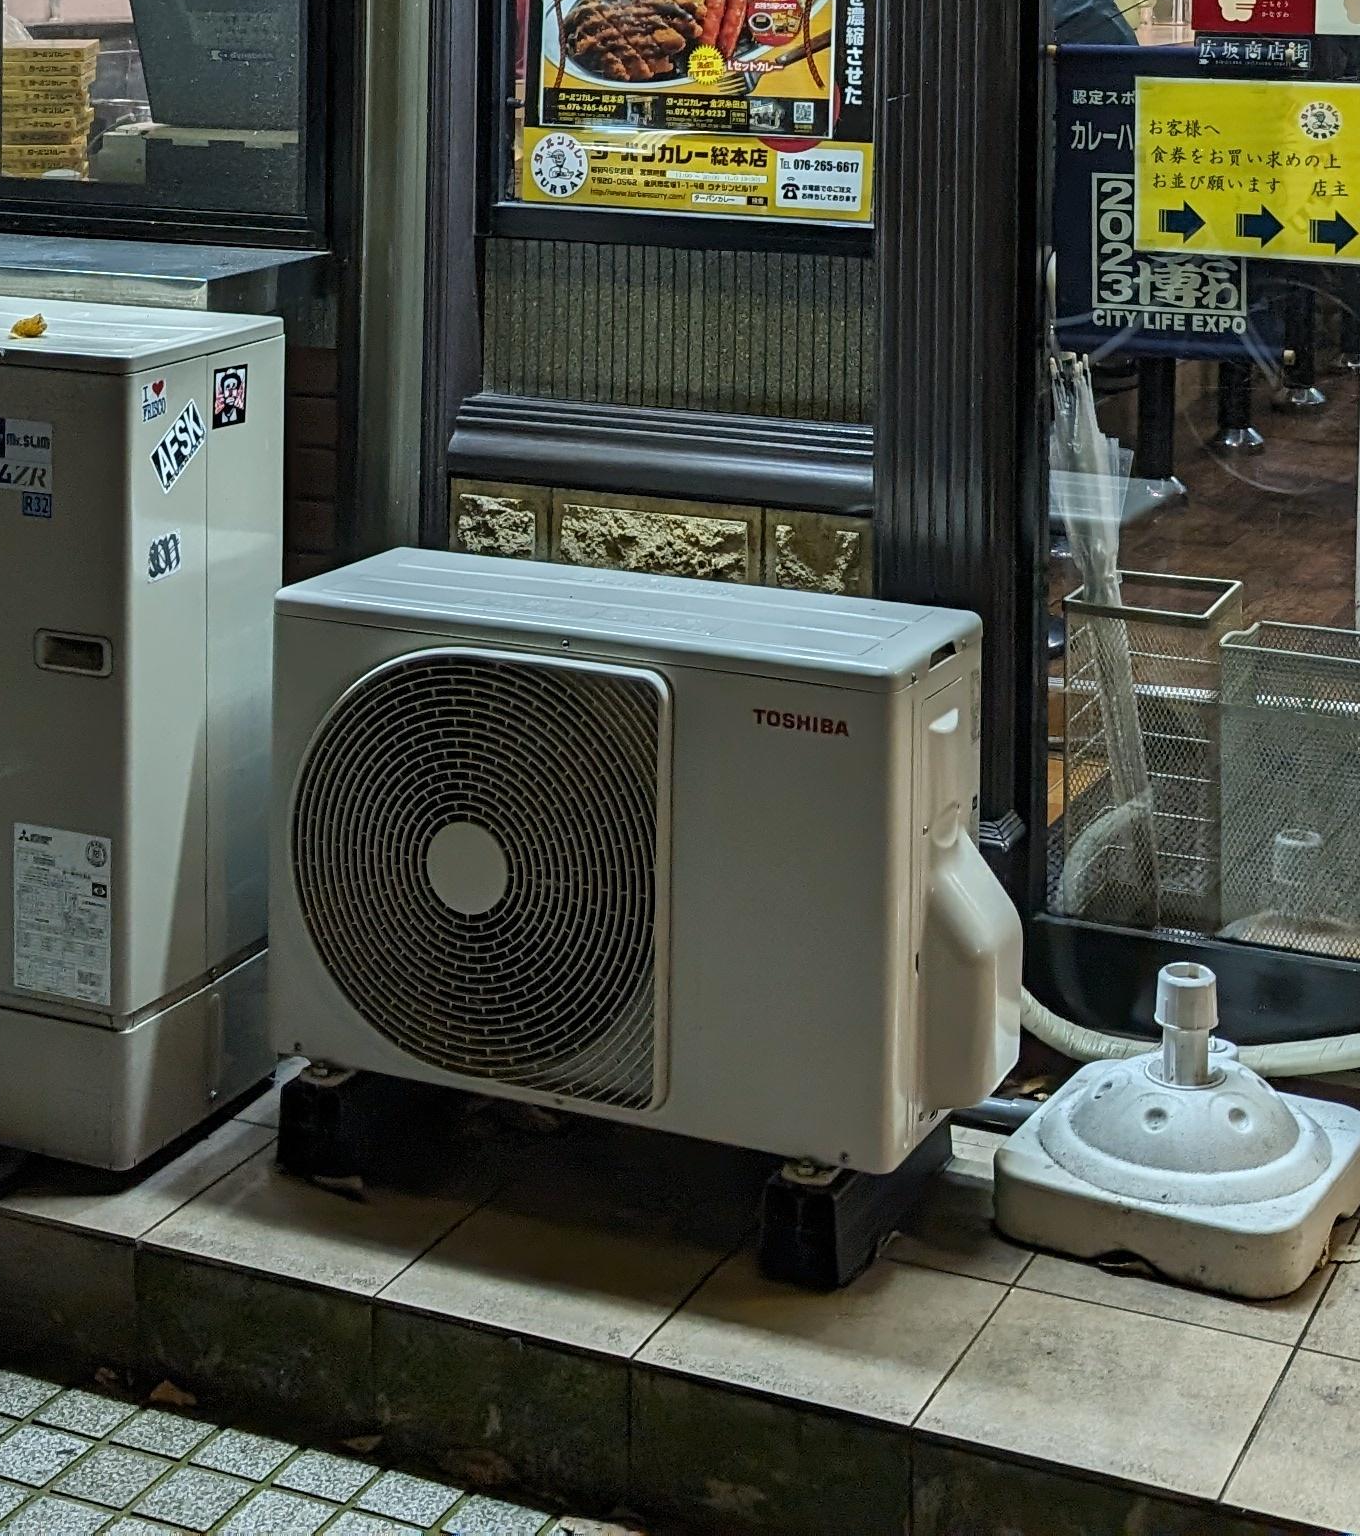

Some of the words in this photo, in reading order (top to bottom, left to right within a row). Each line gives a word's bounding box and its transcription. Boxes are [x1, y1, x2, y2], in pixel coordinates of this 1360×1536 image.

[1199, 39, 1310, 62] 広坂商店街
[1148, 118, 1221, 137] お客様へ
[1301, 122, 1340, 140] TURBAN
[590, 141, 768, 168] タバンカレー総本店
[793, 158, 860, 174] 076-265-6617
[1150, 145, 1342, 169] 食券をお買い求めの上
[535, 167, 585, 195] TURBAN
[1152, 172, 1281, 194] お並び願います
[1311, 179, 1349, 198] 店主
[1091, 309, 1139, 328] CITY
[1144, 311, 1186, 331] LIFE
[1192, 315, 1247, 334] EXPO
[24, 495, 50, 514] R32
[752, 708, 850, 737] TOSHIBA
